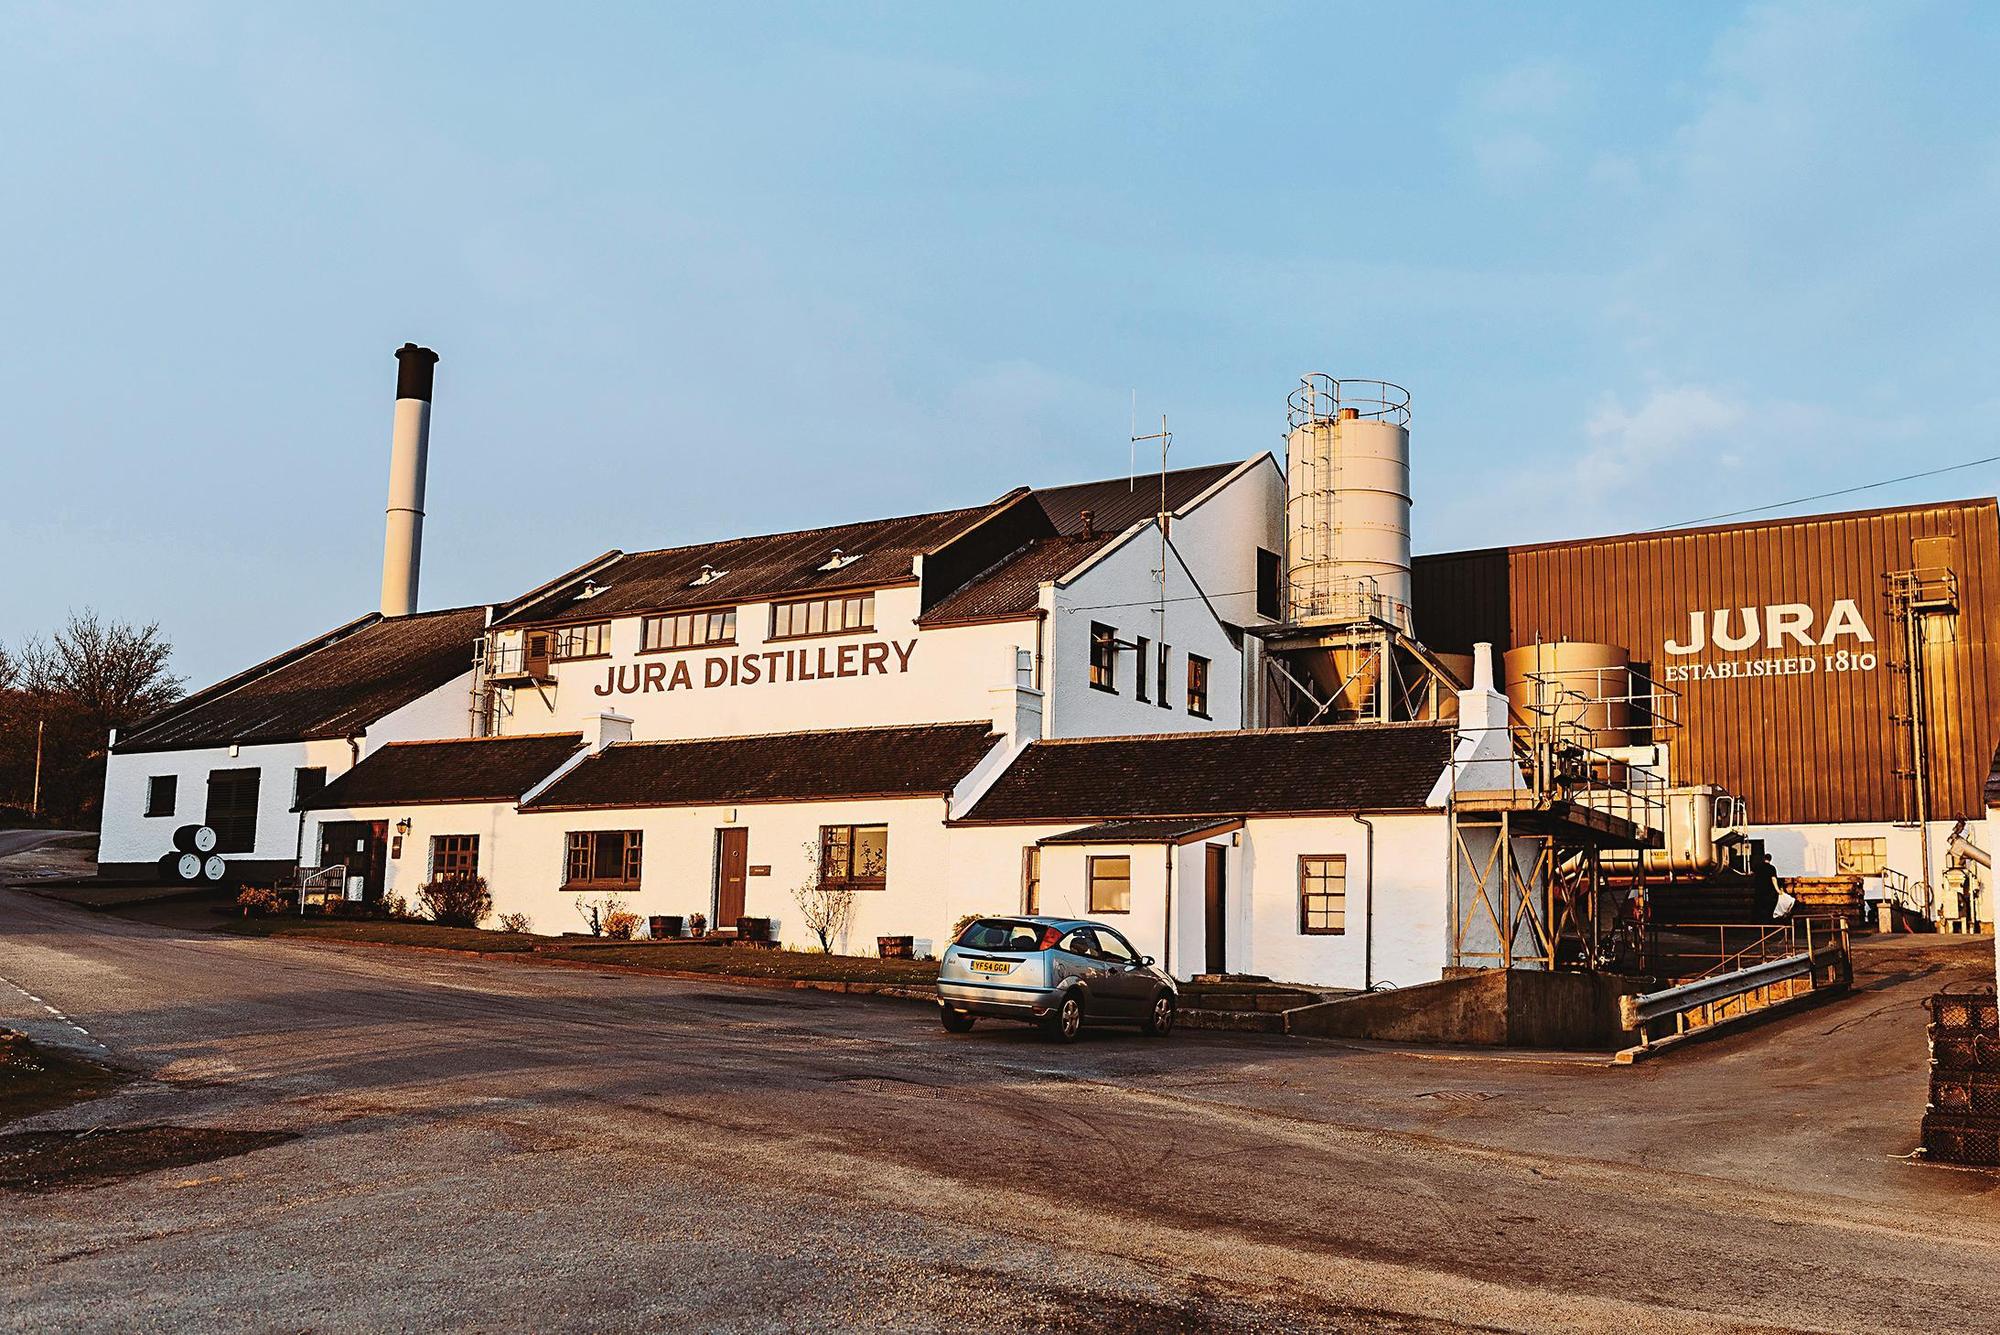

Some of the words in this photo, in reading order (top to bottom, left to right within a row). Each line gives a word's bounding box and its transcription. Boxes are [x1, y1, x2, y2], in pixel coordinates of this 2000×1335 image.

[1664, 599, 1875, 655] JURA
[594, 660, 693, 696] JURA
[704, 639, 918, 688] DISTILLERY
[1665, 656, 1816, 682] ESTABLISHED
[1825, 650, 1876, 672] 1810
[975, 962, 993, 971] YF54
[994, 963, 1008, 972] GGA
